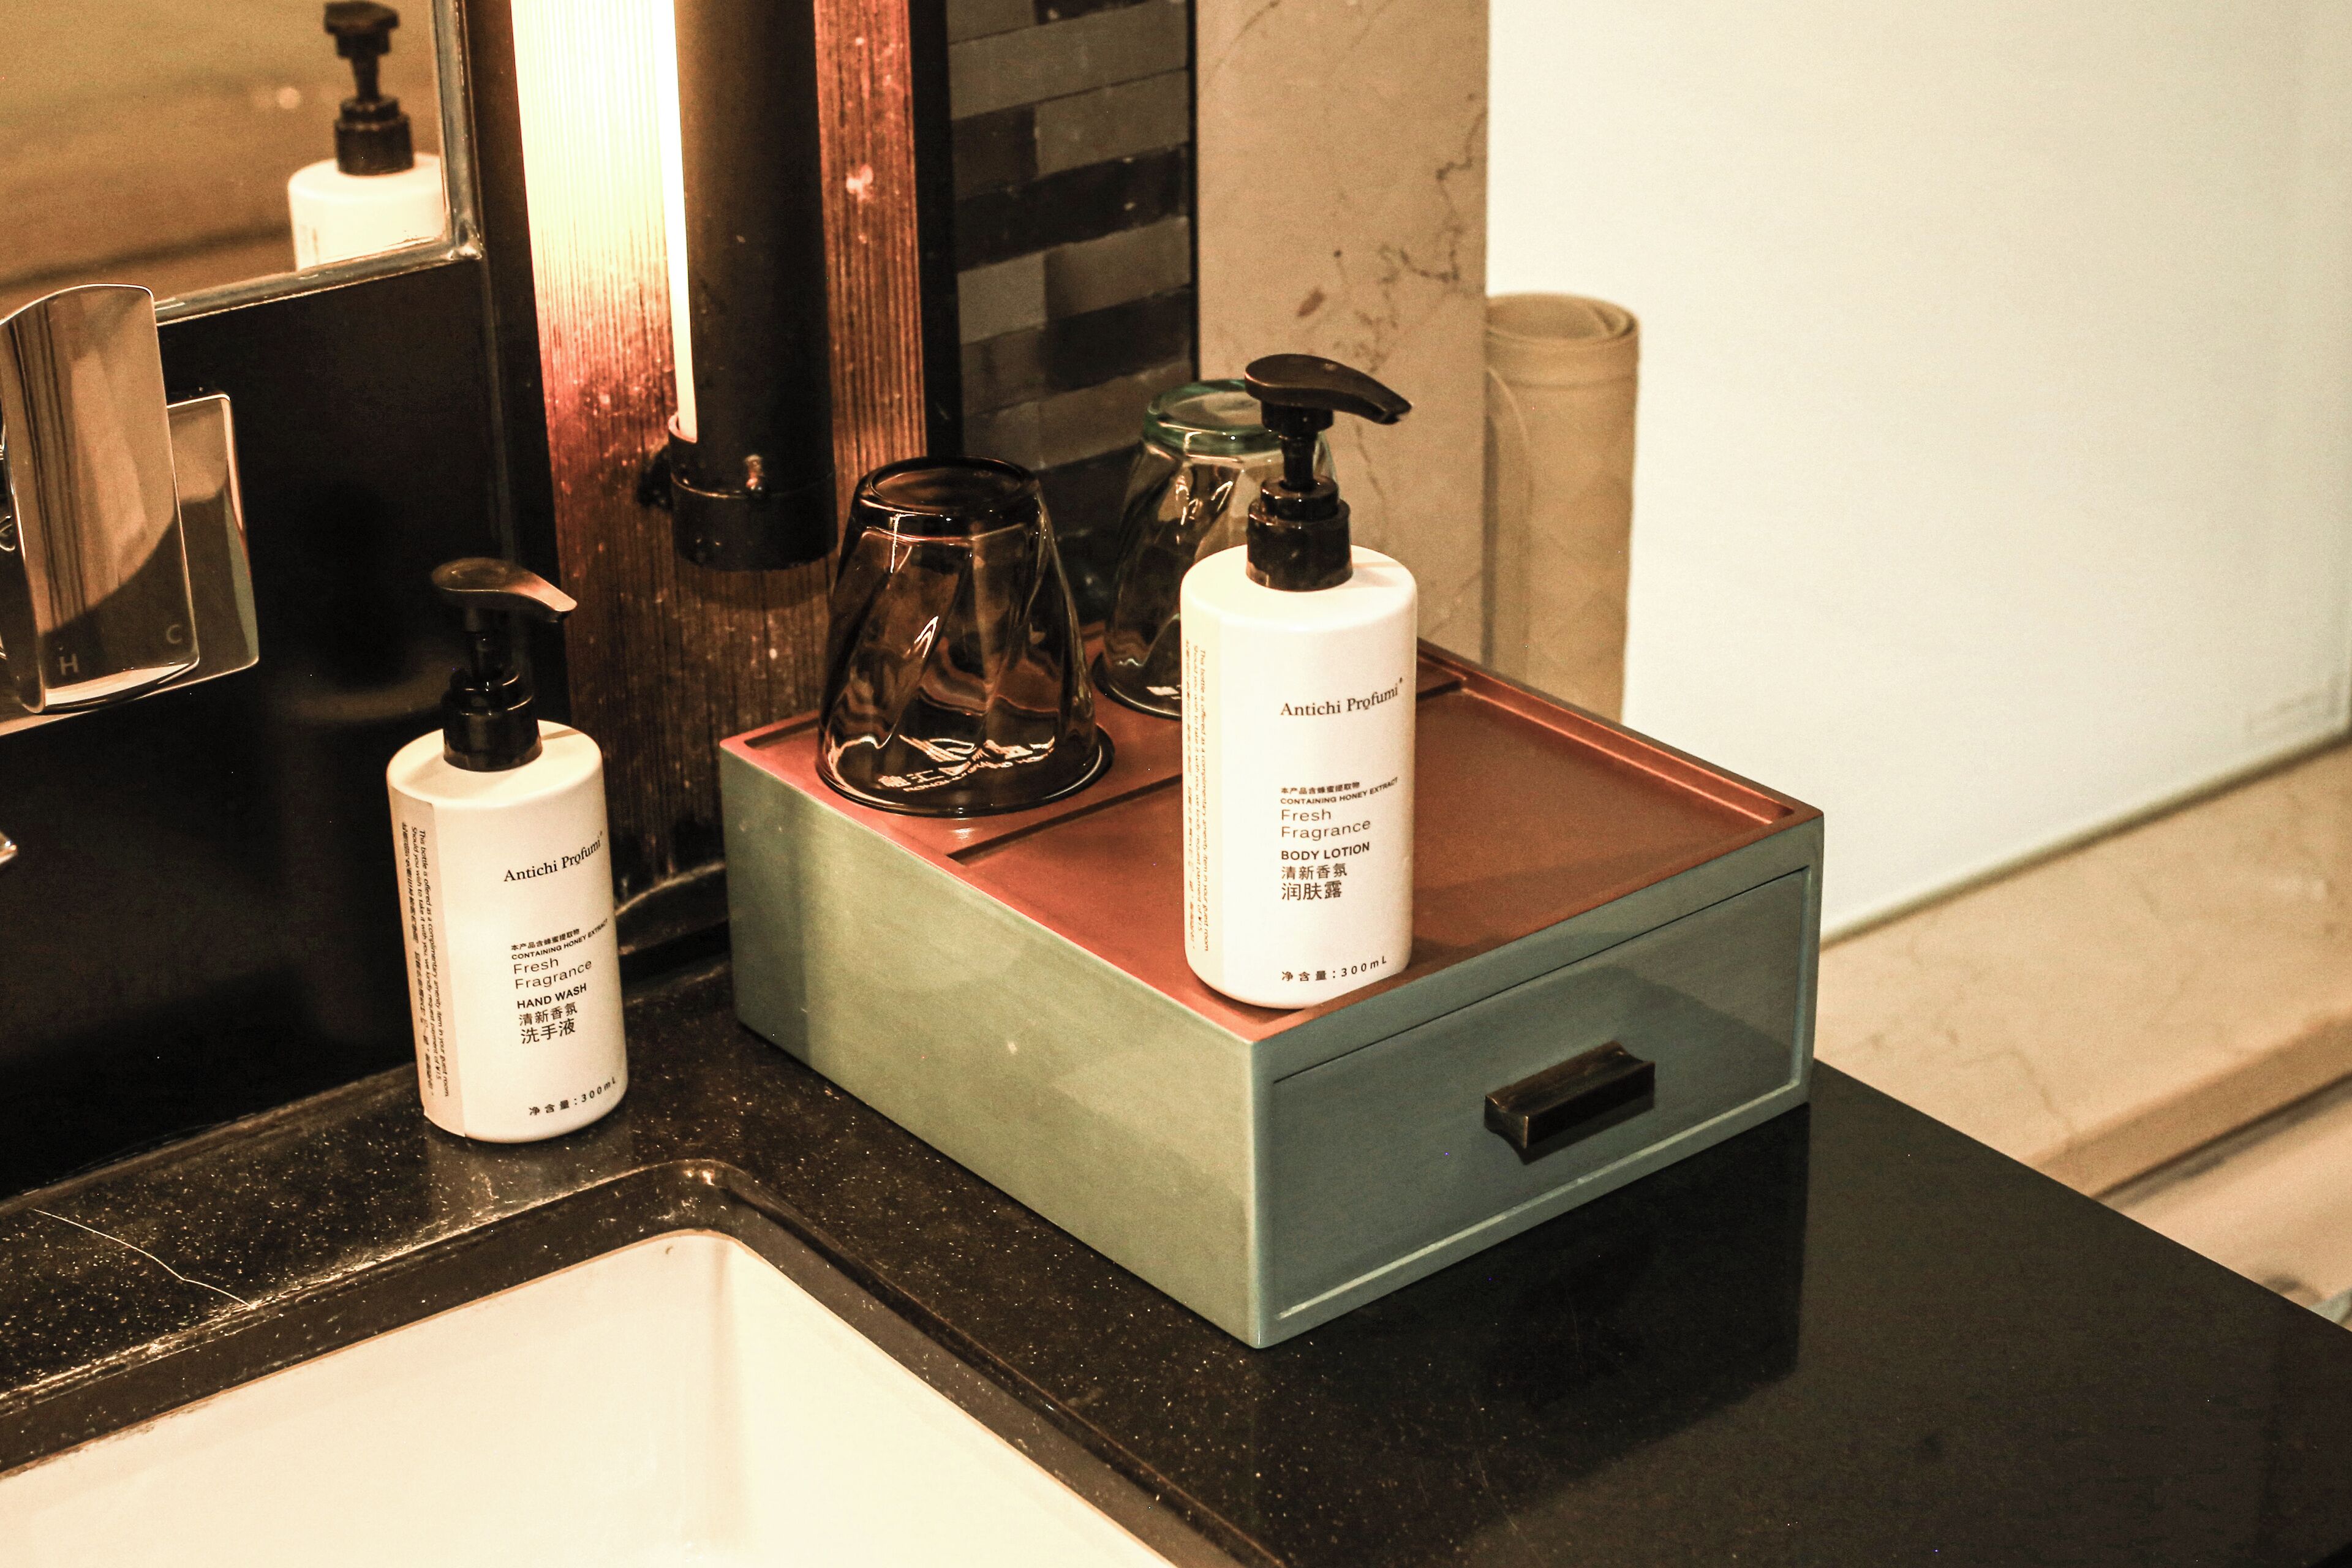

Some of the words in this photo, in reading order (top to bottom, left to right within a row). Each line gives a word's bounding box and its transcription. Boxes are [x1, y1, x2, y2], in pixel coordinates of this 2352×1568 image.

[166, 624, 183, 644] C
[59, 653, 80, 676] H
[1280, 701, 1341, 716] Antichi
[1280, 796, 1336, 804] CONTAINING
[1339, 790, 1368, 802] HONEY
[1370, 777, 1398, 794] EXTRACT
[1281, 809, 1332, 821] Fresh
[1281, 820, 1371, 841] Fragrance
[1281, 850, 1319, 861] BODY
[1324, 841, 1370, 859] LOTION
[503, 860, 558, 882] Antichi
[1281, 862, 1348, 880] 清新香氛
[1281, 880, 1343, 901] 润肤露
[511, 945, 562, 960] CONTAINING
[564, 935, 587, 949] HONEY
[587, 918, 608, 938] EXTRACT
[513, 957, 559, 974] Fresh
[515, 960, 592, 989] Fragrance
[517, 995, 552, 1009] HAND
[554, 982, 587, 1001] WASH
[519, 1002, 578, 1027] 清新香氛
[521, 1018, 576, 1044] 洗手液
